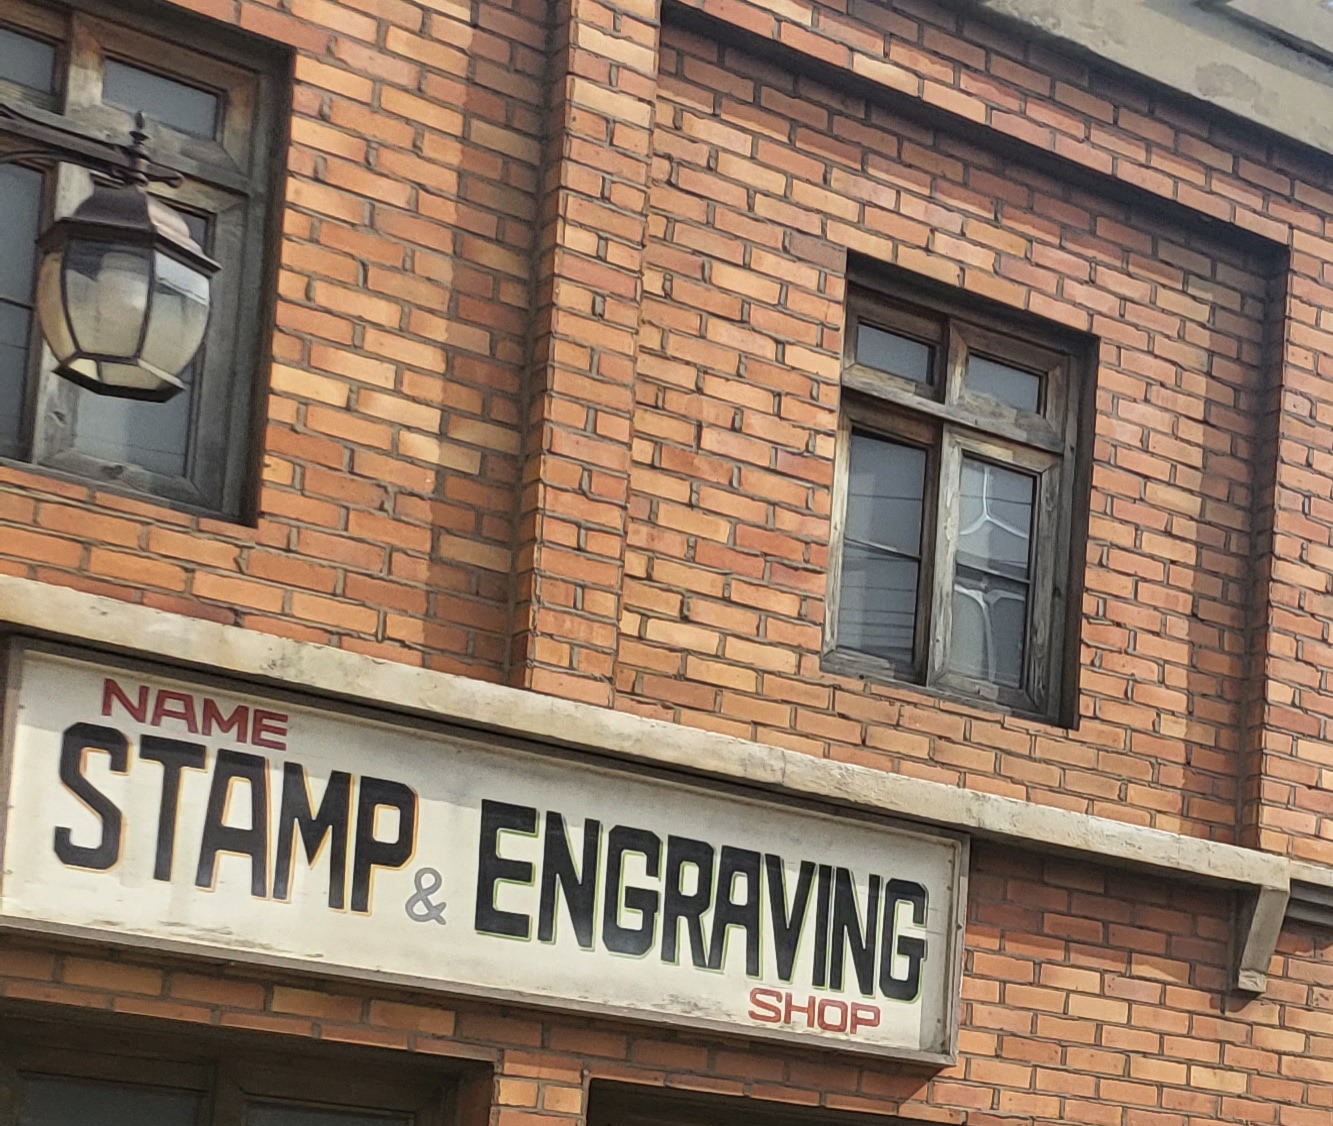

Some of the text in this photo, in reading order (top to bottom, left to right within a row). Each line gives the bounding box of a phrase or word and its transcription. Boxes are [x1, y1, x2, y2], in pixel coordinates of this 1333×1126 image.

[103, 678, 289, 751] NAME
[52, 721, 932, 1002] STAMP & ENGRAVING
[747, 987, 882, 1037] SHOP
